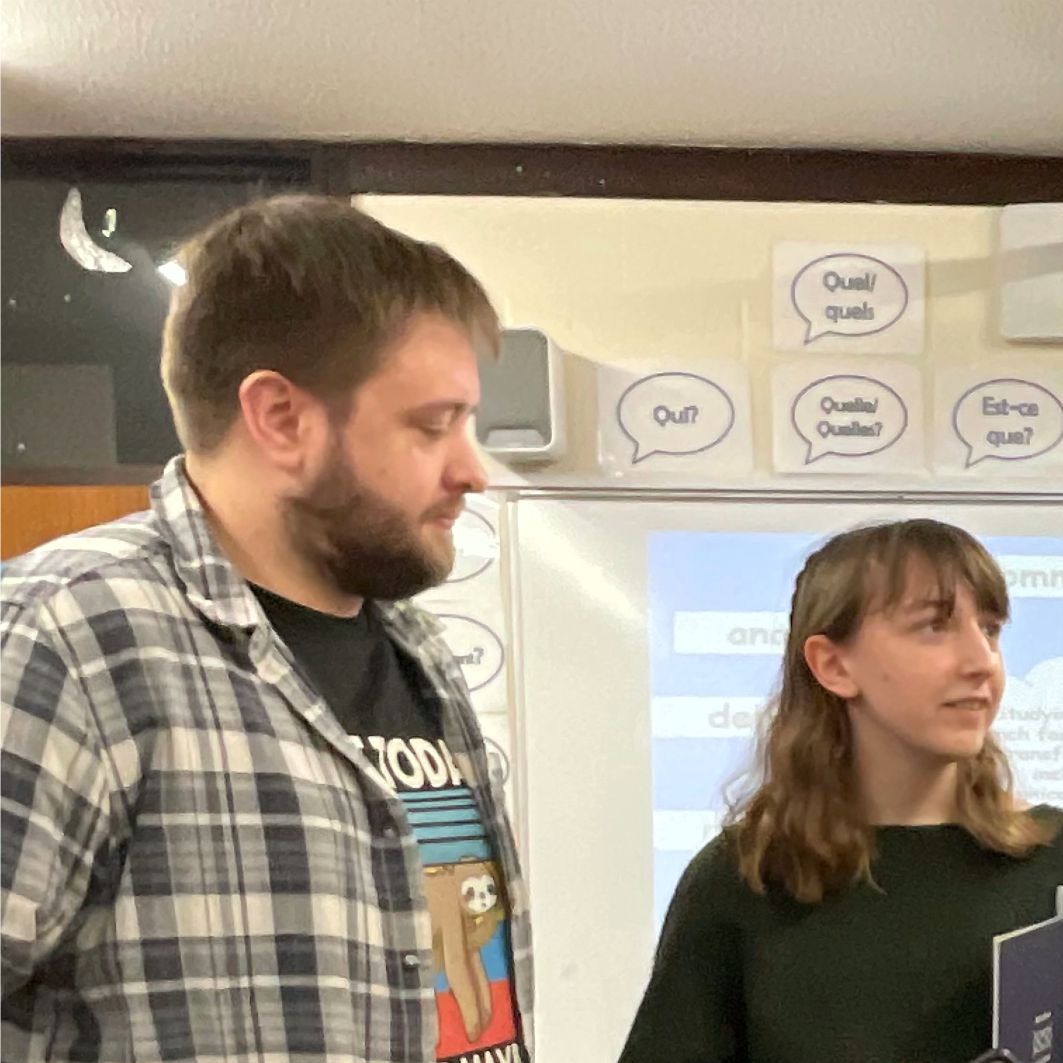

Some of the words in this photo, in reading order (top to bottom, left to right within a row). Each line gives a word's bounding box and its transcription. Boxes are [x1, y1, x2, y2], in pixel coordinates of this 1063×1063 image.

[822, 270, 877, 293] Quel/
[652, 404, 699, 427] Qui?
[982, 396, 1039, 417] Est-ce
[986, 427, 1034, 447] que?
